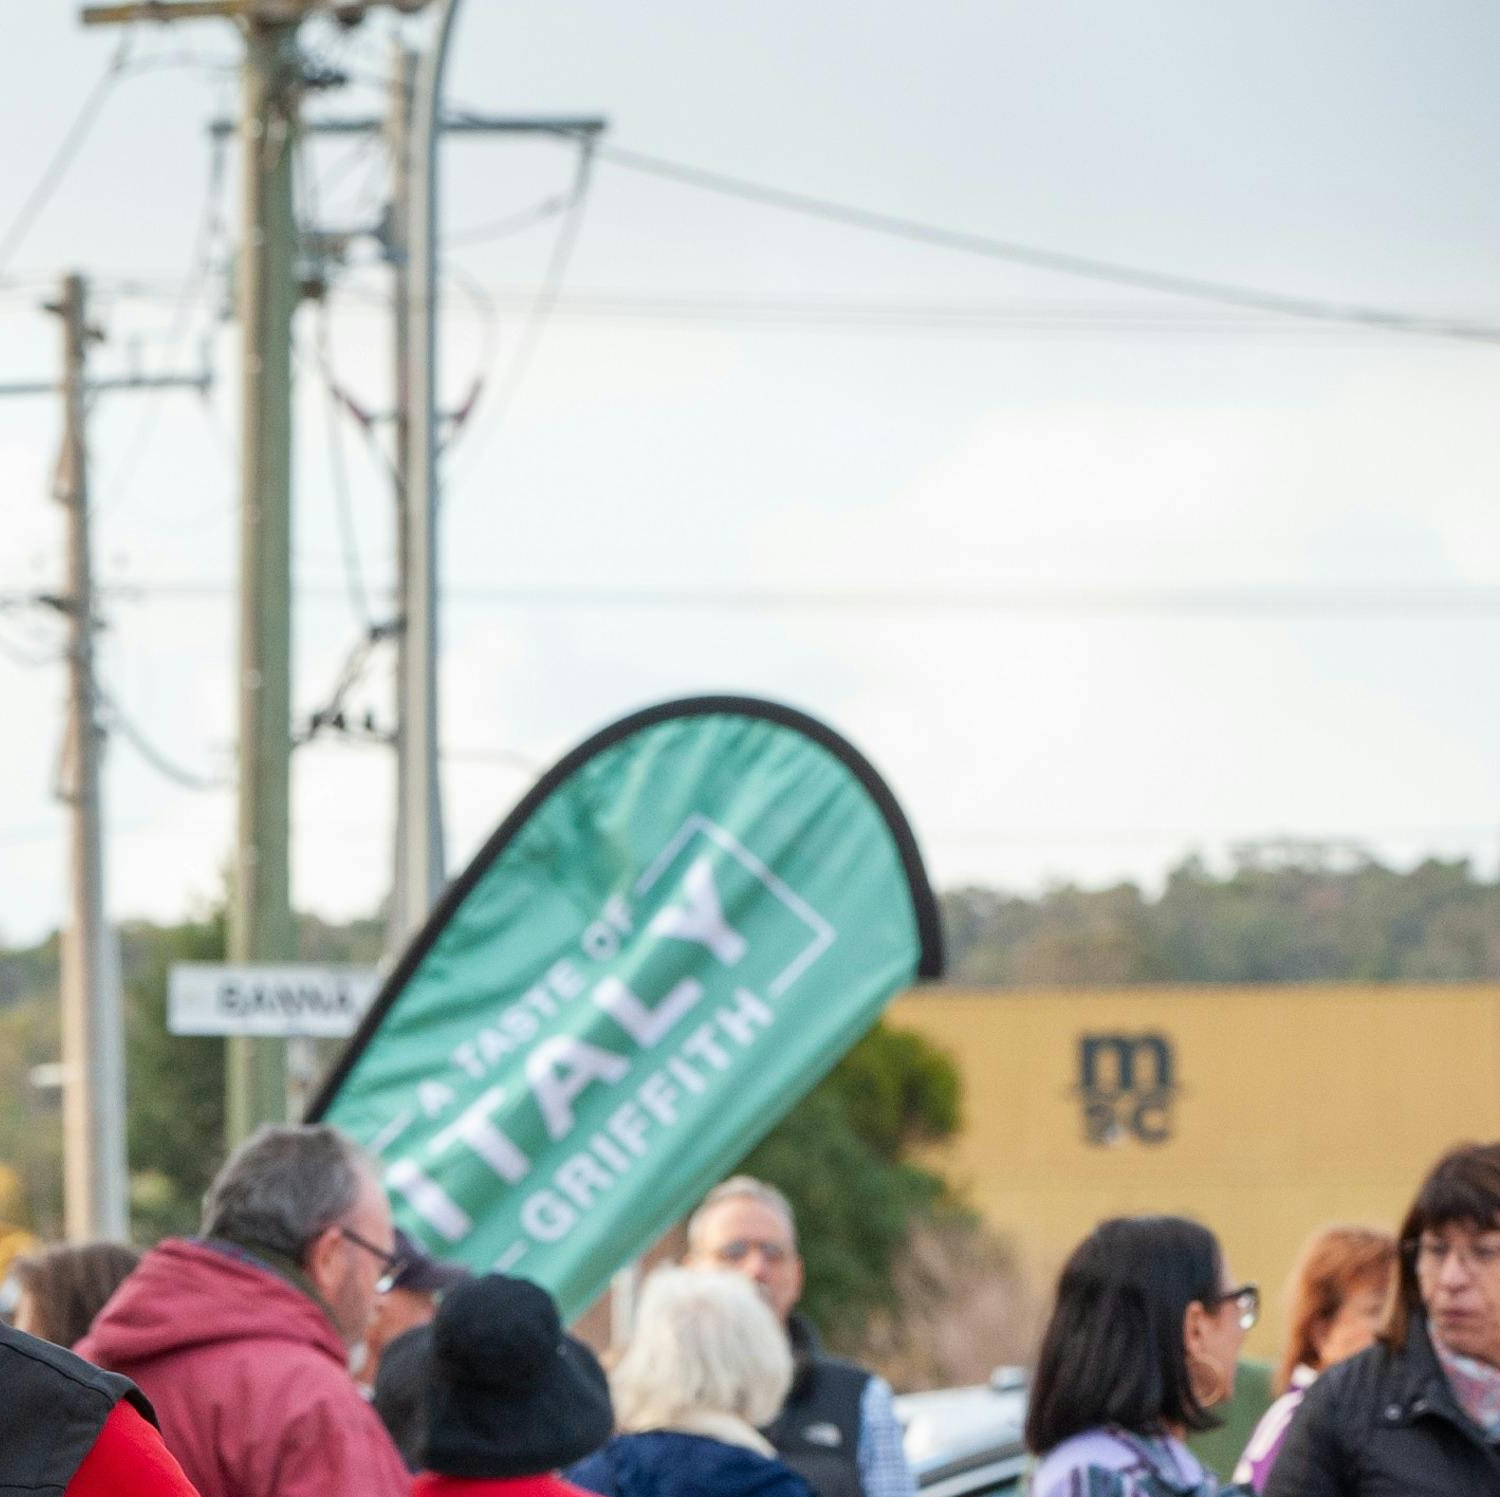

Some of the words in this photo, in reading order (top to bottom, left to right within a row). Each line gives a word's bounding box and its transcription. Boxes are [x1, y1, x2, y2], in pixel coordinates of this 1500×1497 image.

[385, 854, 747, 1243] ITALY
[416, 1080, 454, 1118] A
[451, 960, 587, 1080] TASTE
[583, 895, 638, 962] OF
[519, 986, 774, 1245] GRIFFITH
